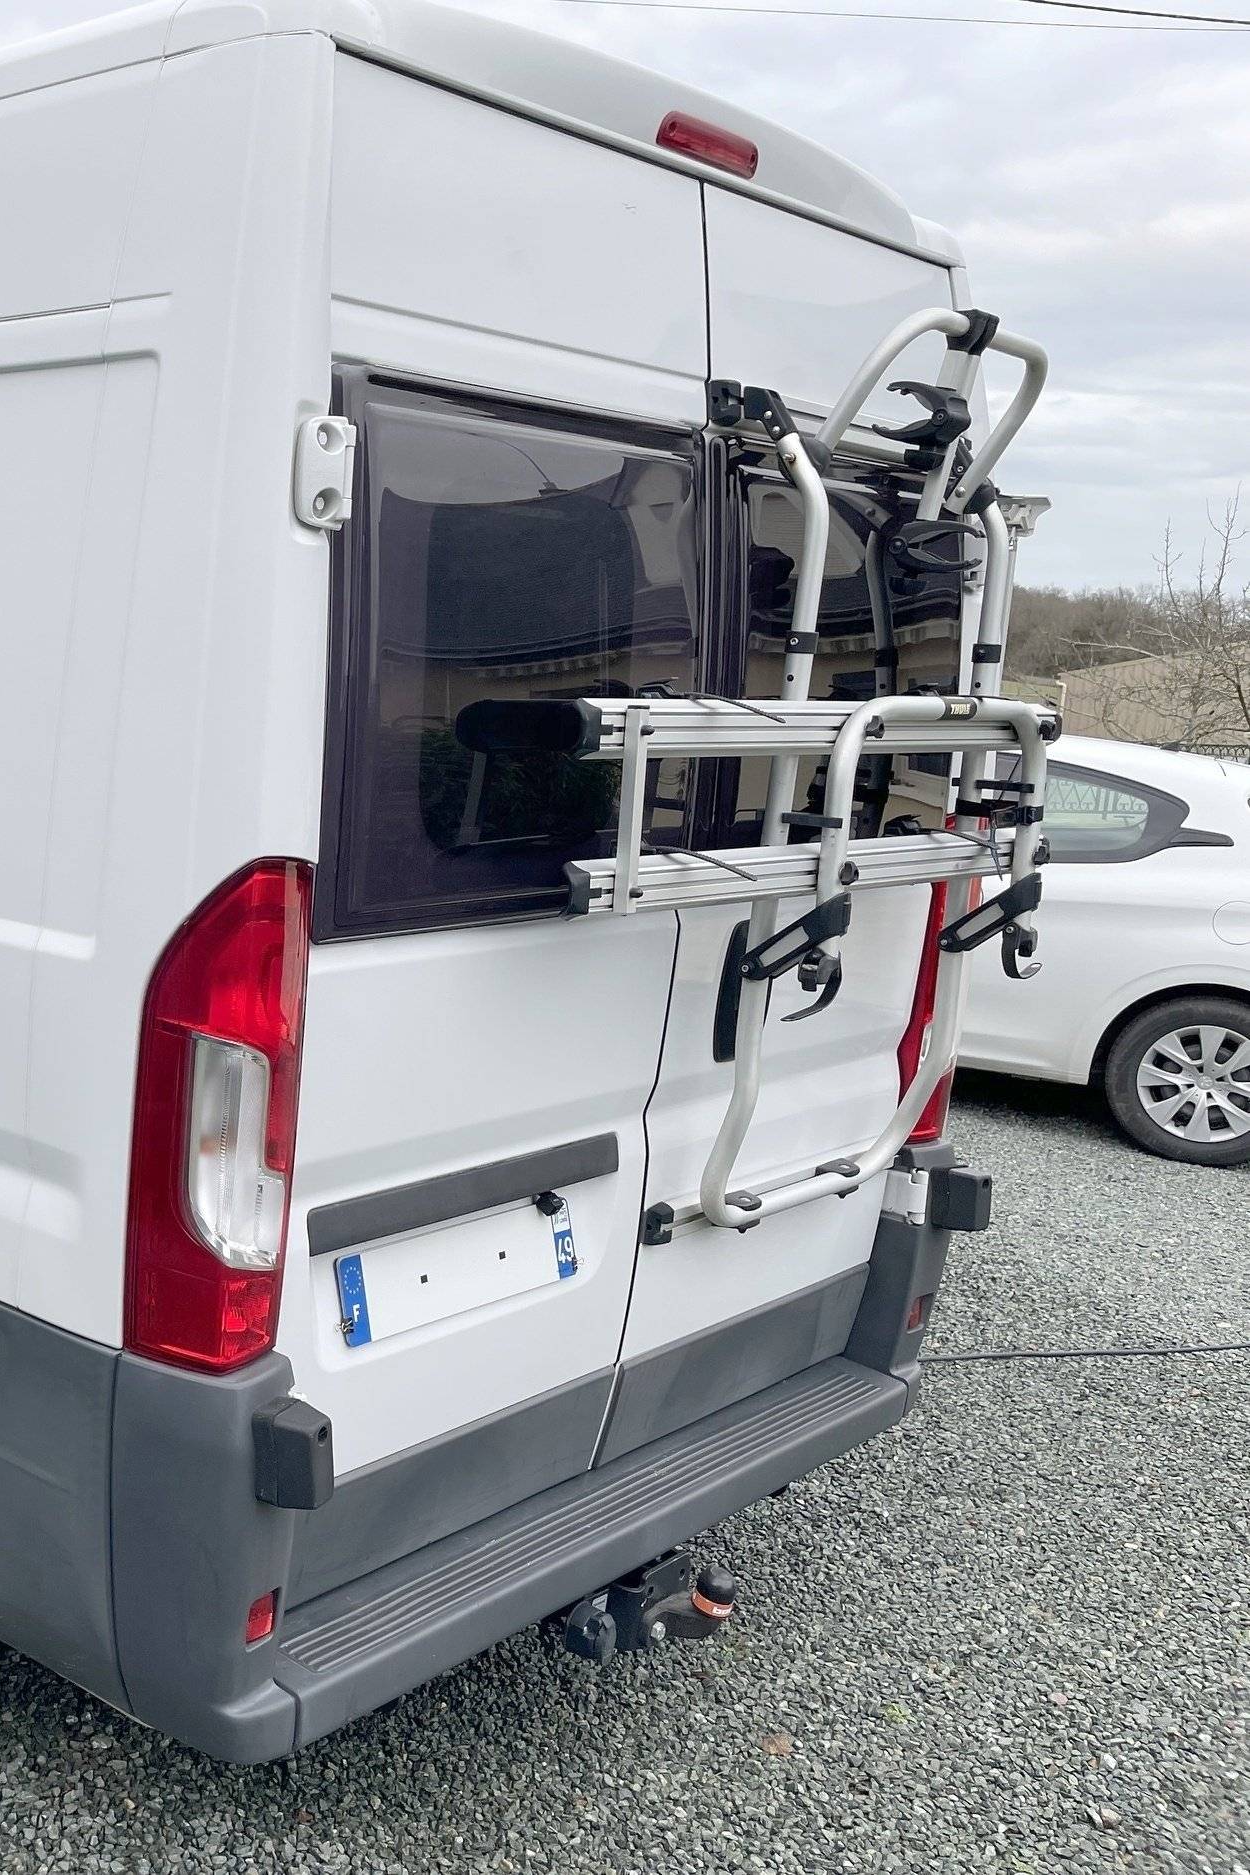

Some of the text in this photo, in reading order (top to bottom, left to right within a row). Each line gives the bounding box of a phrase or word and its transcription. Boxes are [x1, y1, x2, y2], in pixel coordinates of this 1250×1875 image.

[950, 703, 971, 714] THULE
[558, 1236, 574, 1263] 49
[352, 1303, 360, 1323] F
